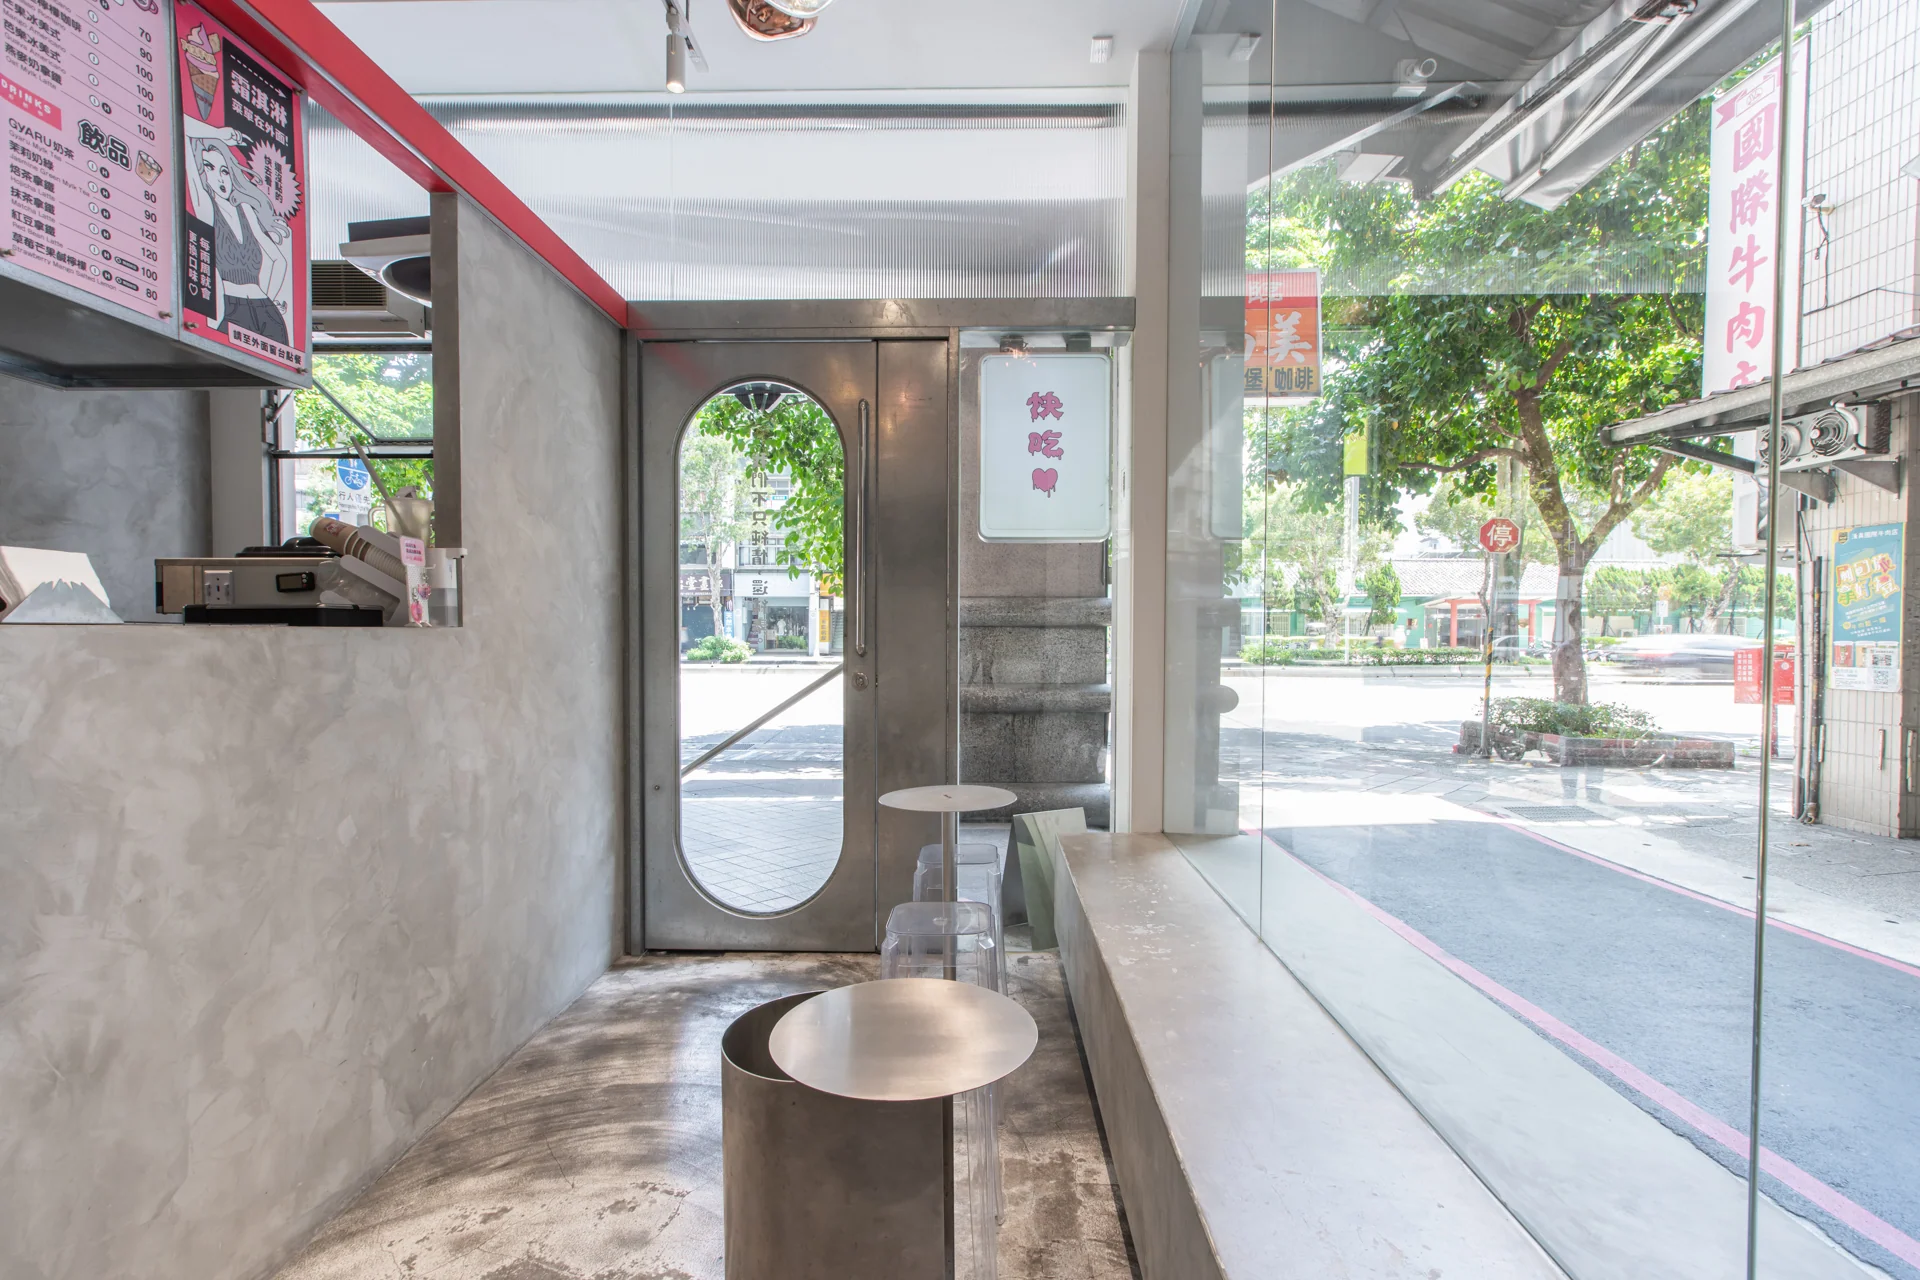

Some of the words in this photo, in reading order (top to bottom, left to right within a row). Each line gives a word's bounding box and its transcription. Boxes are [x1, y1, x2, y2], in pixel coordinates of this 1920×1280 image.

[29, 0, 81, 32] 檸檬咖啡
[30, 26, 66, 52] Americano
[138, 26, 152, 43] 70
[5, 41, 62, 85] 燕麥奶拿鐵
[30, 48, 66, 74] Americano
[139, 47, 153, 63] 90
[39, 75, 57, 90] Latte
[135, 64, 153, 82] 100
[1, 78, 51, 115] DRINKS
[136, 84, 154, 102] 100
[231, 69, 288, 128] 霜淇淋
[137, 104, 155, 122] 100
[79, 120, 131, 170] 飲品
[137, 124, 155, 141] 100
[9, 139, 54, 171] 茉莉奶綠
[50, 151, 62, 162] Tea
[9, 153, 38, 172] Jasmine
[40, 167, 61, 182] Green
[79, 186, 90, 197] Tea
[9, 163, 55, 193] 焙茶拿鐵
[10, 186, 55, 215] 抹茶拿鐵
[38, 188, 55, 201] Latte
[144, 190, 157, 204] 80
[11, 198, 37, 215] Matcha
[38, 211, 56, 223] Latte
[11, 209, 56, 237] 紅豆拿鐵
[144, 209, 157, 223] 90
[12, 221, 26, 232] Red
[28, 228, 45, 240] Bean
[46, 236, 64, 249] Latte
[140, 227, 157, 243] 120
[12, 231, 87, 271] 草莓芒果鹹檸檬
[141, 247, 158, 262] 120
[12, 244, 51, 265] Strawberry
[52, 261, 75, 275] Mango
[75, 270, 95, 283] Salted
[96, 278, 117, 291] Lemon
[141, 266, 158, 281] 100
[146, 288, 158, 301] 80
[233, 329, 302, 366] 請至外面窗台點餐
[1275, 366, 1314, 391] 咖啡
[1486, 524, 1513, 547] 停
